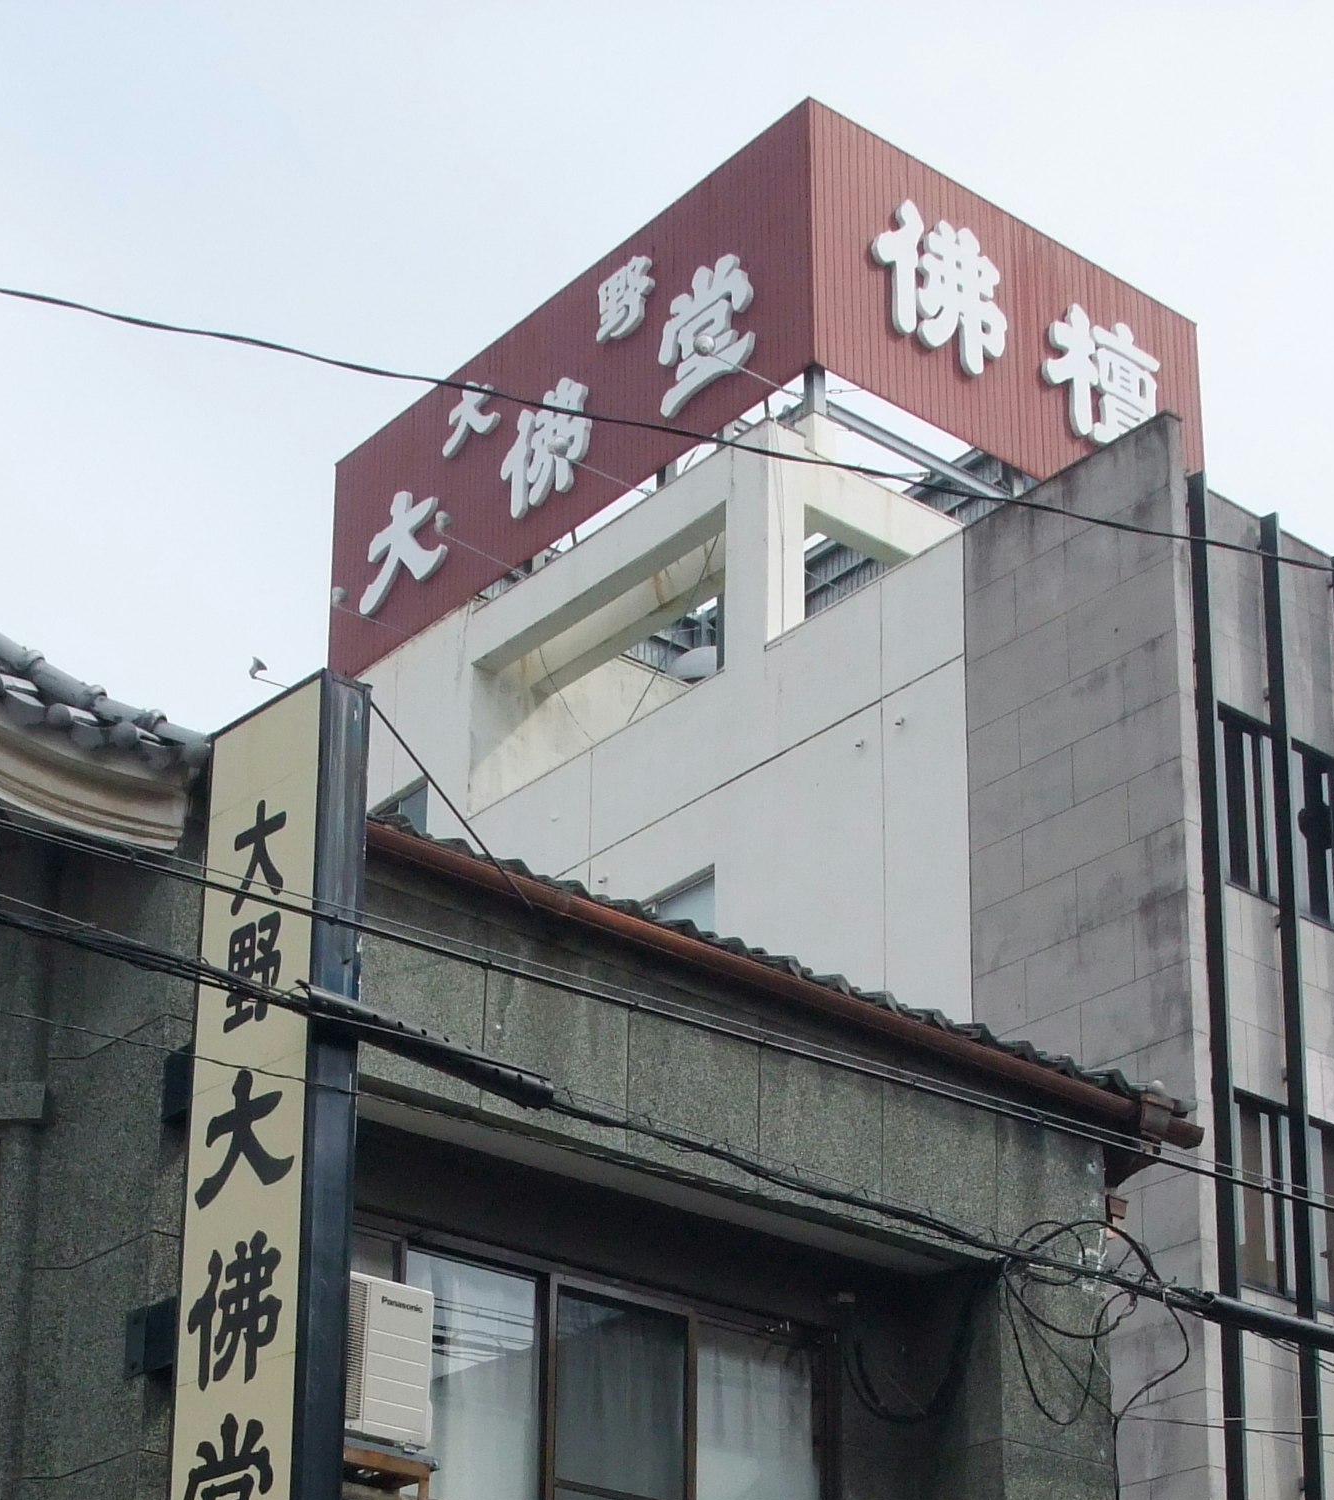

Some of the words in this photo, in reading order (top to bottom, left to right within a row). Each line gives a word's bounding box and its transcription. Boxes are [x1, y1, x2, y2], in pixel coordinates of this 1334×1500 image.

[359, 253, 756, 616] 大佛堂
[381, 1296, 423, 1313] Panasonic
